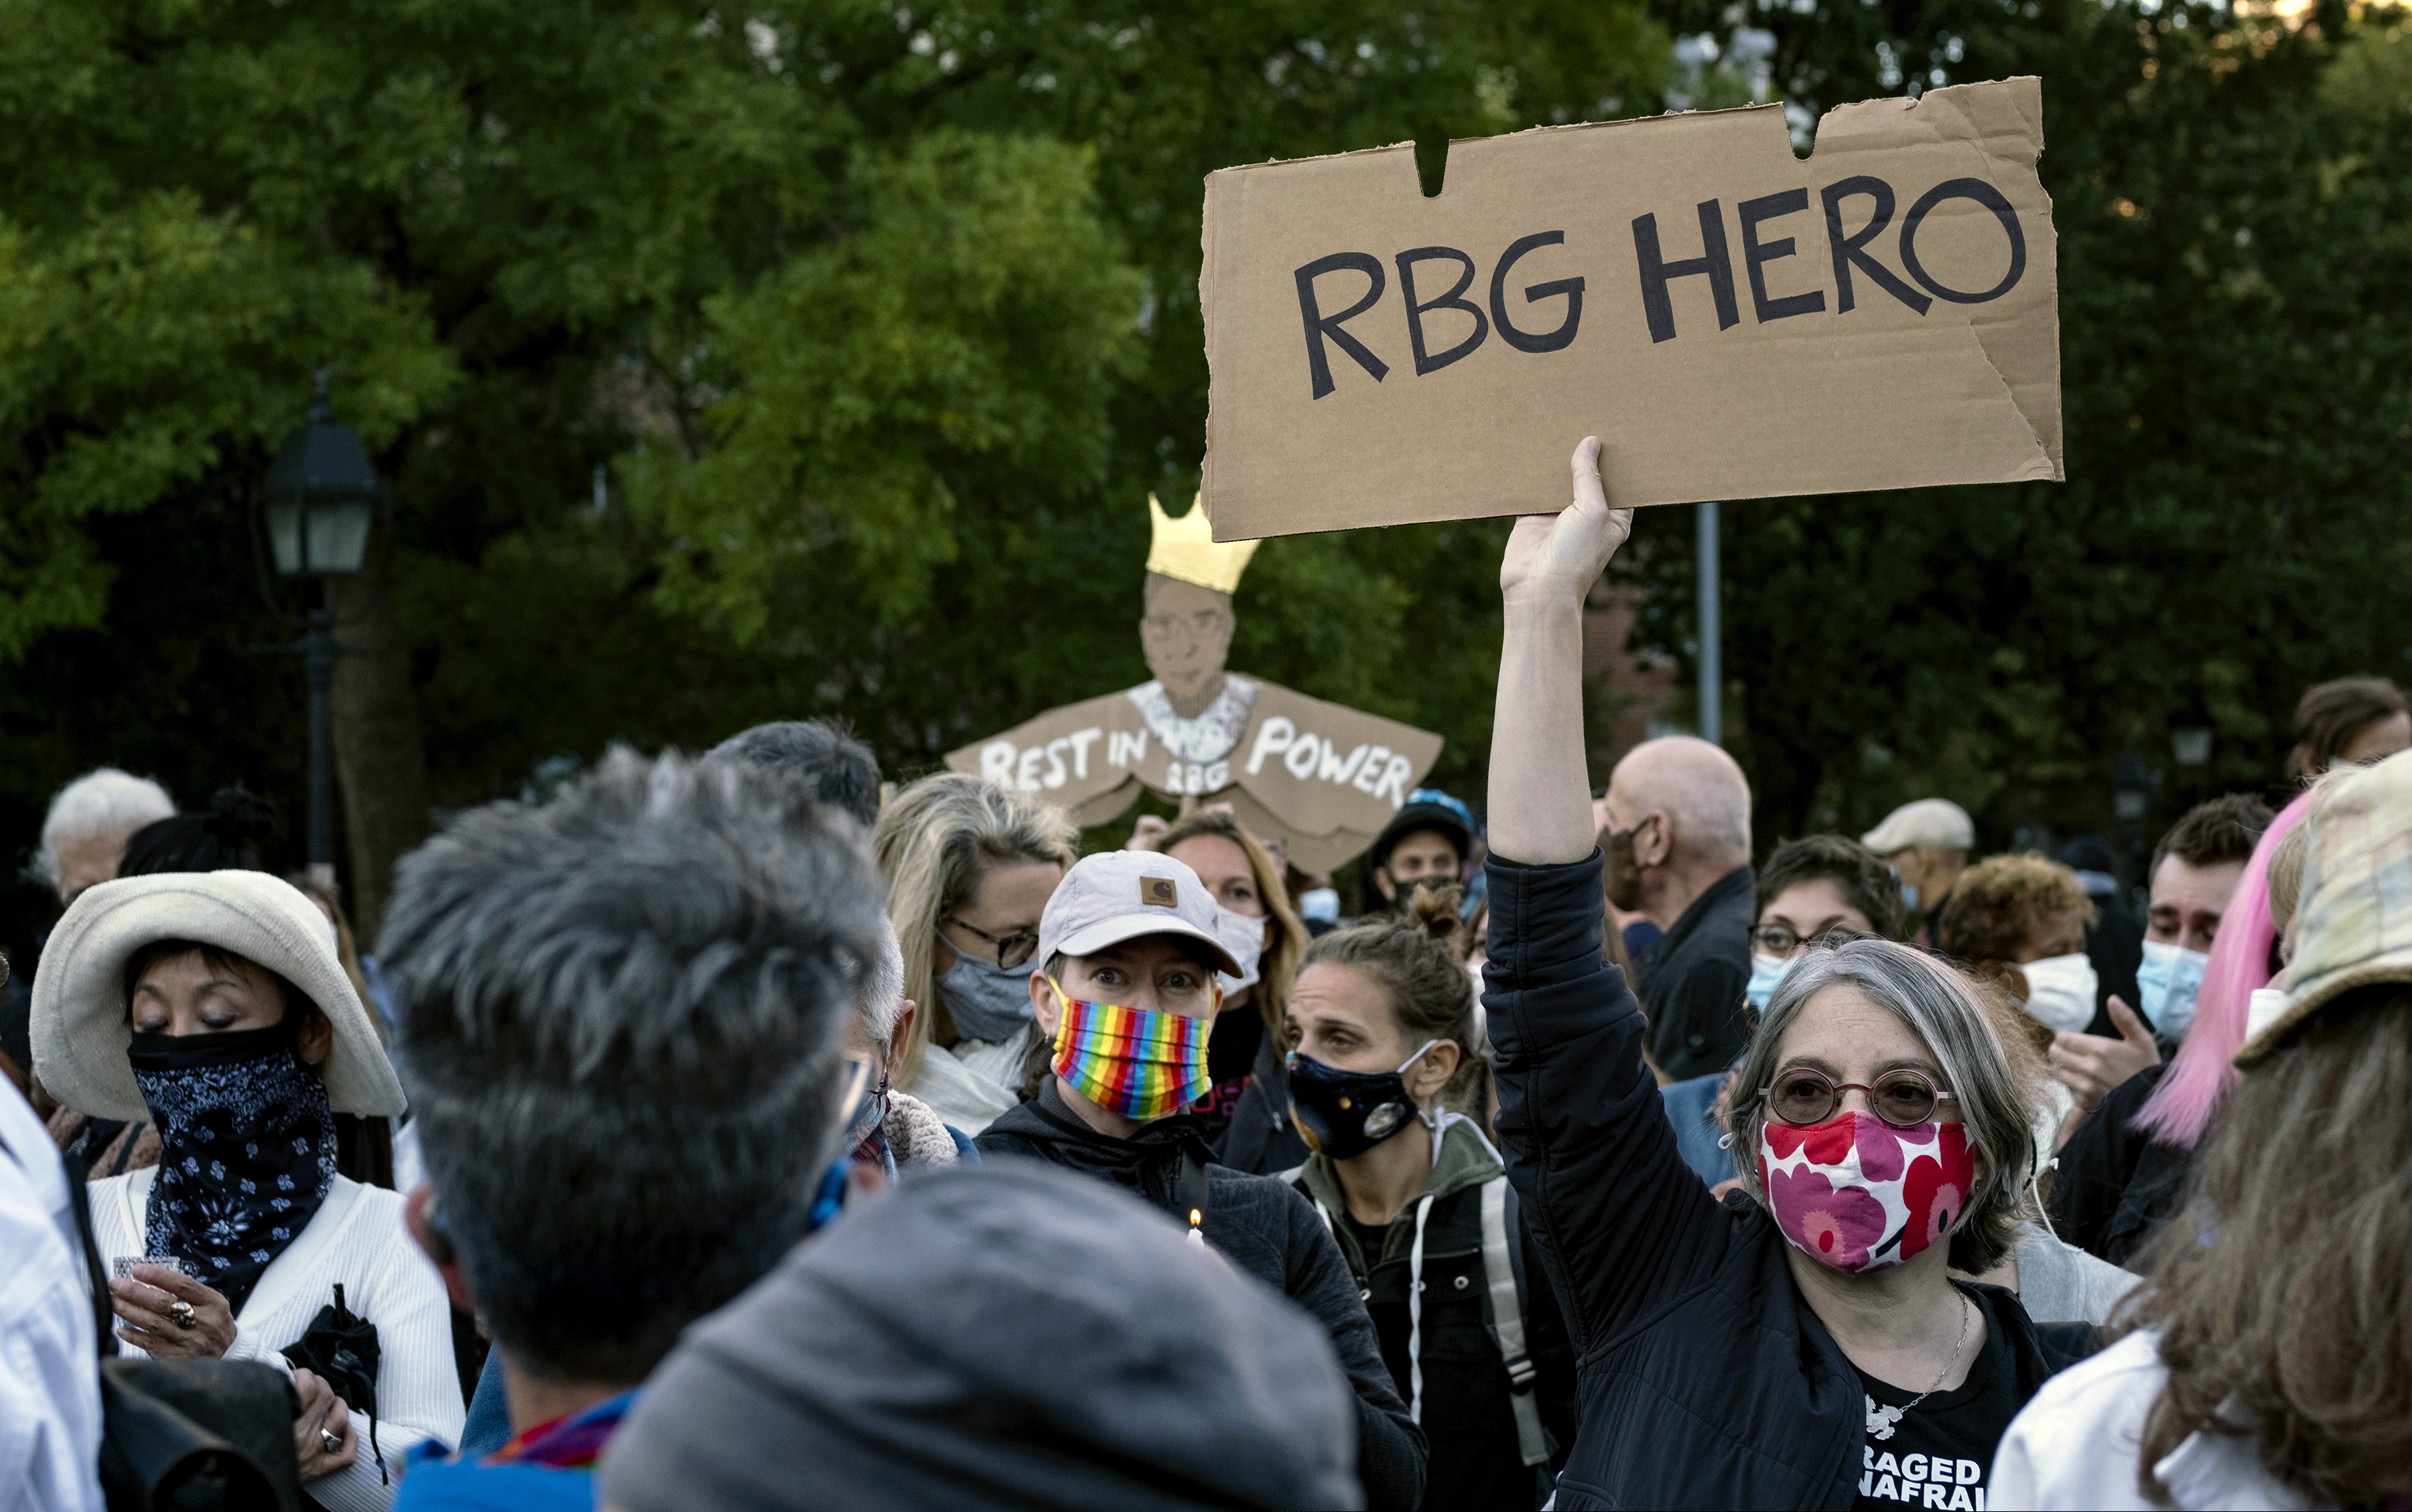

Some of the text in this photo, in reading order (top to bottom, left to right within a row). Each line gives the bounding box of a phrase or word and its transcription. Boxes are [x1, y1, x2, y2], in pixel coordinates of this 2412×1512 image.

[1294, 175, 2027, 401] RBG HERO
[980, 715, 1412, 810] REST IN POWER
